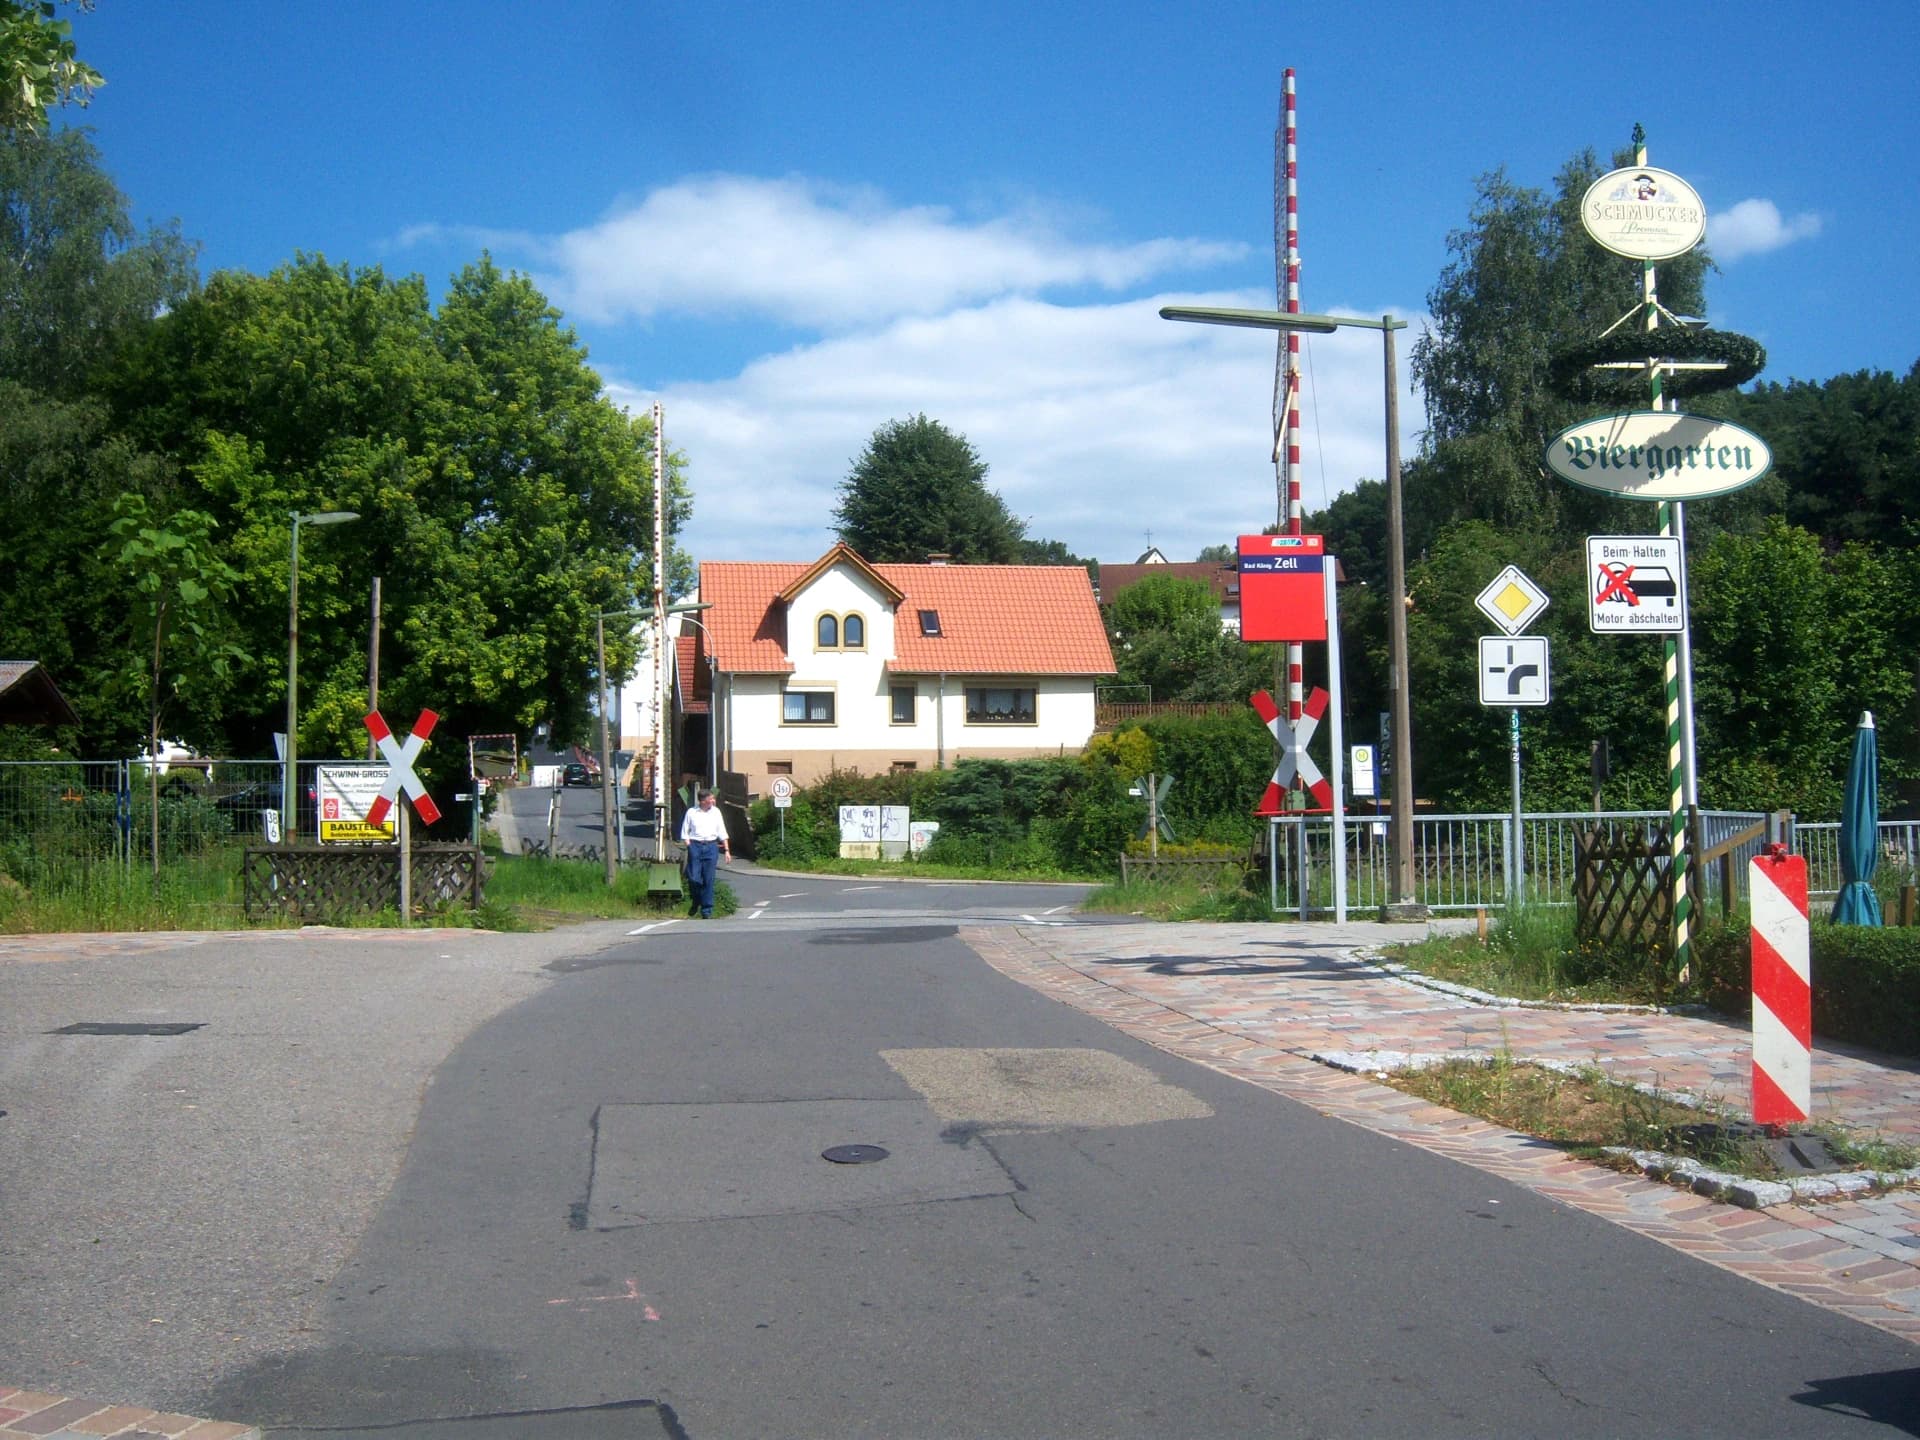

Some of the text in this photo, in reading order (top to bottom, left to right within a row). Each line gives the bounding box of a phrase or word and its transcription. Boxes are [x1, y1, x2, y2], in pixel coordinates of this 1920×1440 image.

[1591, 202, 1698, 223] SCHMUCKER
[1565, 435, 1752, 481] Biergarten
[1603, 546, 1666, 558] Beim Halten
[1274, 557, 1298, 569] Zell
[1597, 612, 1679, 624] Motor abschalten
[330, 823, 387, 831] BAUSTELE
